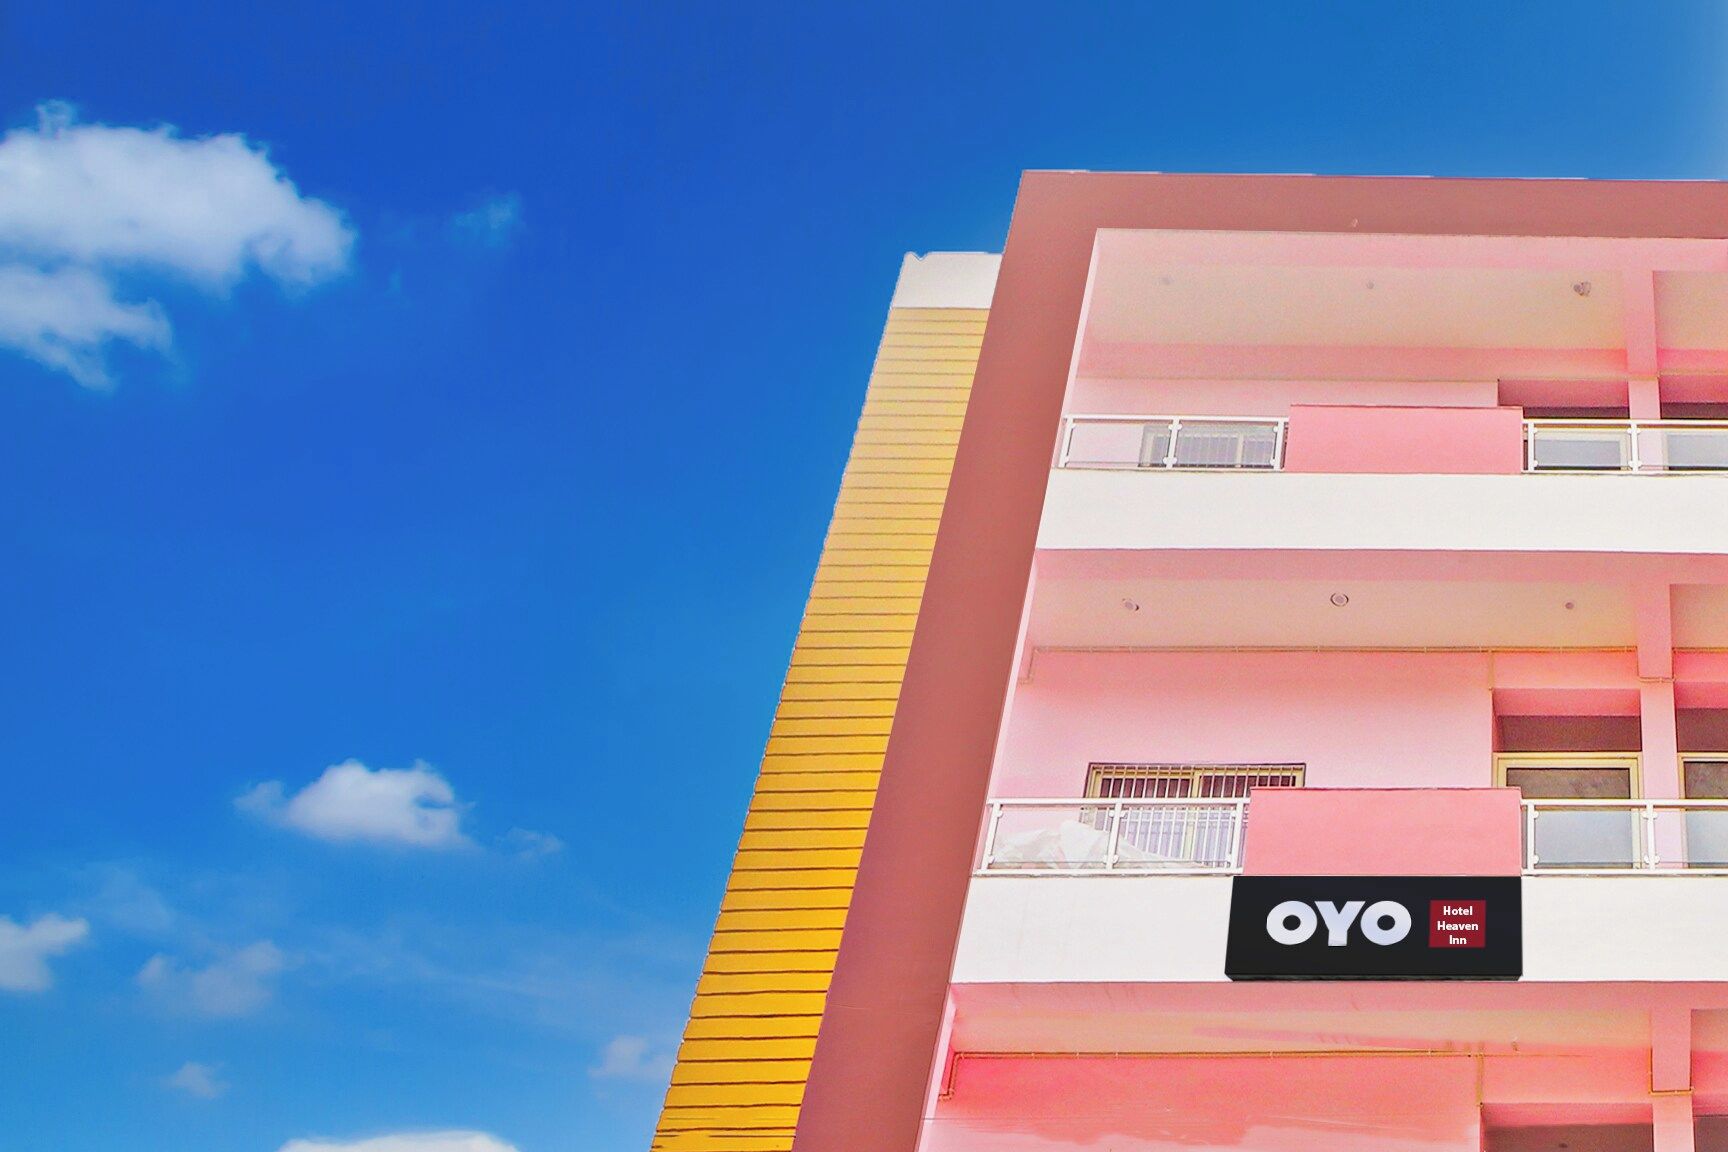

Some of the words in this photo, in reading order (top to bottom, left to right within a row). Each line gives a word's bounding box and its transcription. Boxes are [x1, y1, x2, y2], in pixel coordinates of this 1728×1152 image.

[1443, 905, 1473, 916] Hotel
[1266, 900, 1412, 947] OYO
[1437, 920, 1479, 931] Heaven
[1449, 934, 1467, 945] Inn
